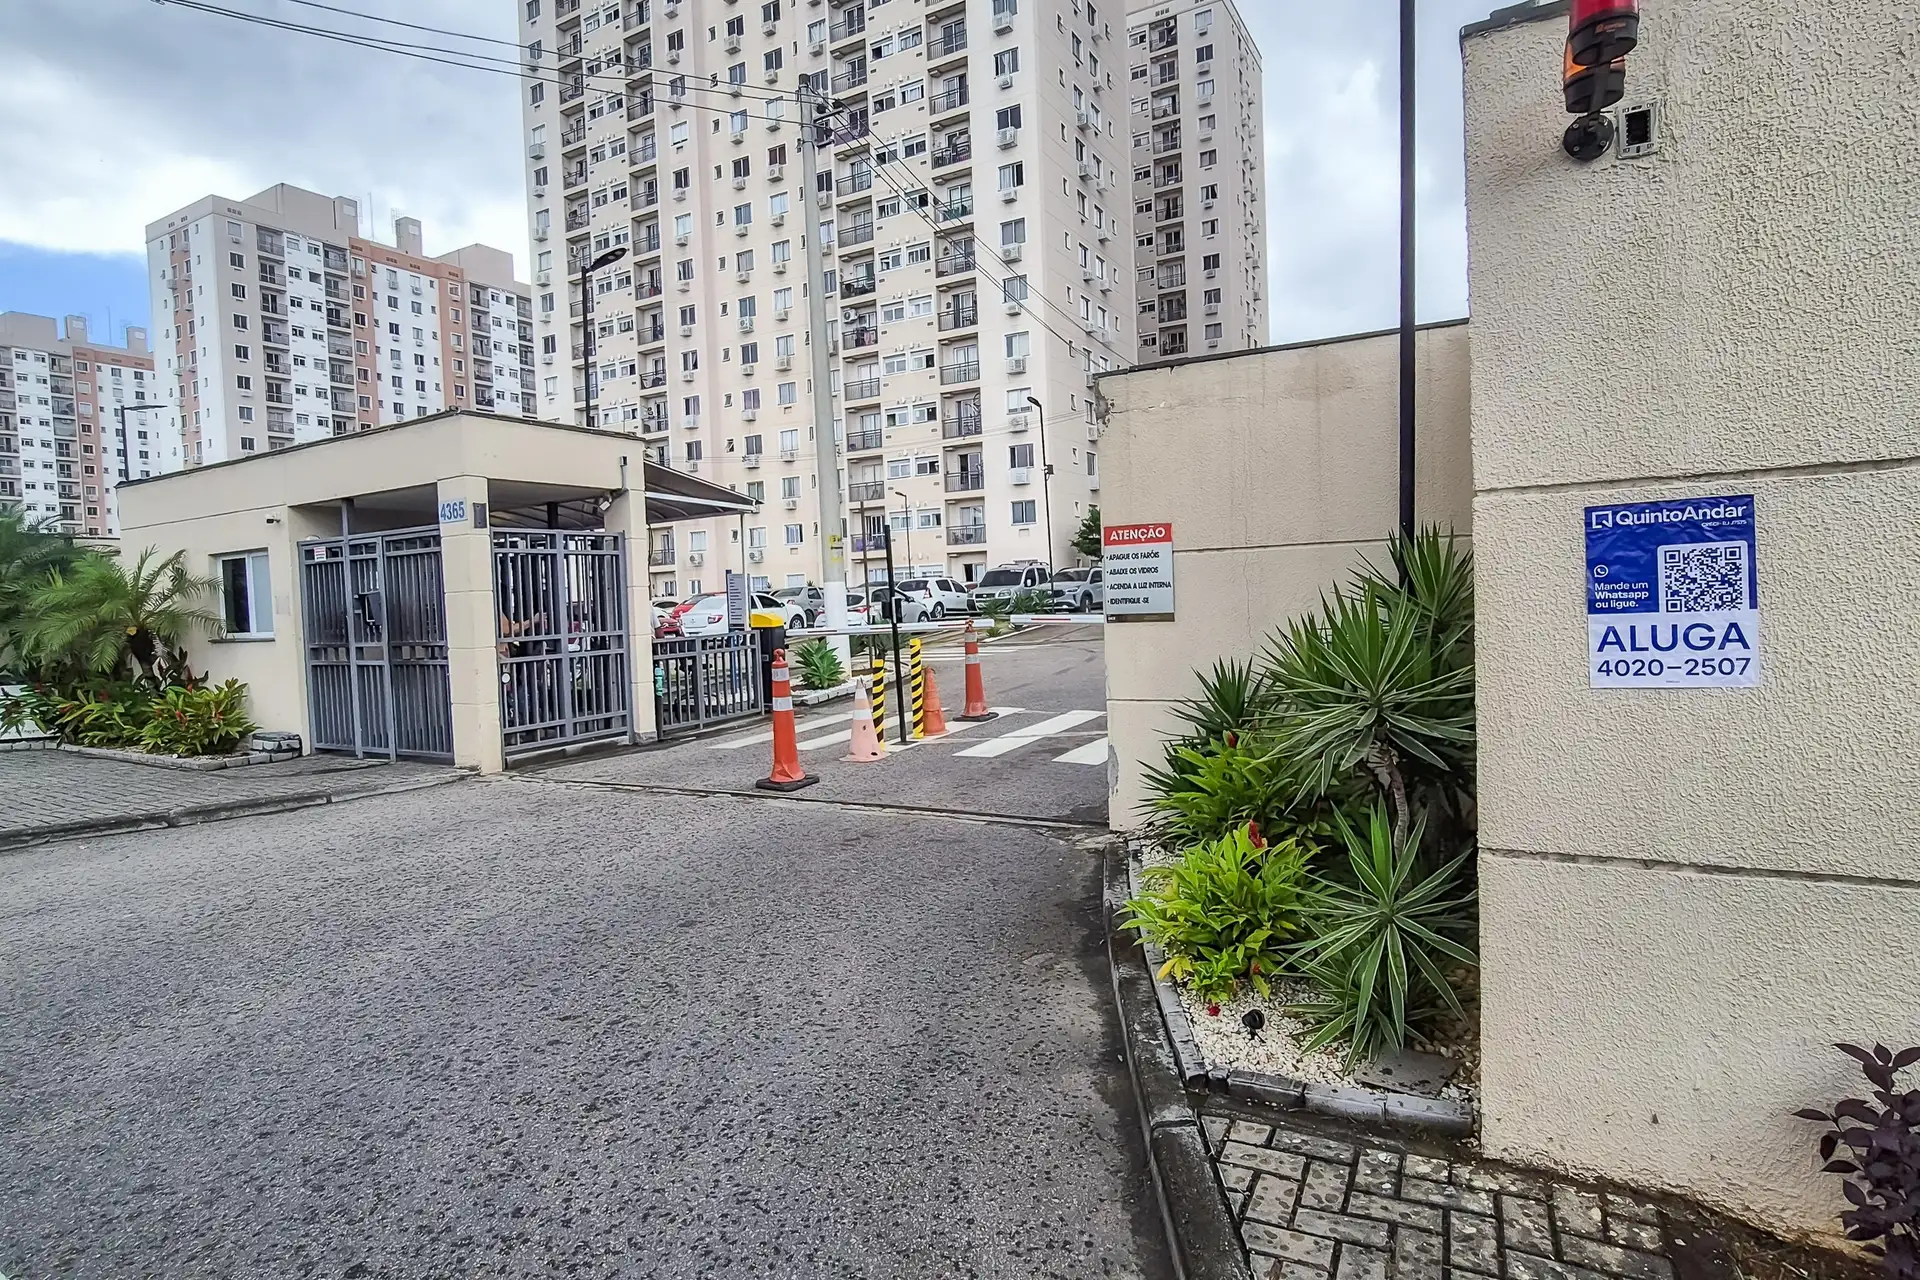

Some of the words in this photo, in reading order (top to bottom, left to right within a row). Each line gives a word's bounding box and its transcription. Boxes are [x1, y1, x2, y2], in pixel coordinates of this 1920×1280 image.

[440, 501, 465, 521] 4365
[1615, 504, 1747, 526] QuintoAndar
[1110, 525, 1166, 541] ATENÇÃO
[1108, 553, 1131, 561] APAGUE
[1131, 552, 1139, 560] OS
[1140, 550, 1160, 559] FARÓIS
[1137, 566, 1159, 574] VIDROS
[1148, 581, 1172, 589] INTERNA
[1594, 581, 1630, 591] Mande
[1595, 590, 1649, 600] Whatsapp
[1610, 600, 1639, 610] ligue.
[1597, 622, 1751, 652] ALUGA
[1597, 657, 1752, 677] 4020-2507
